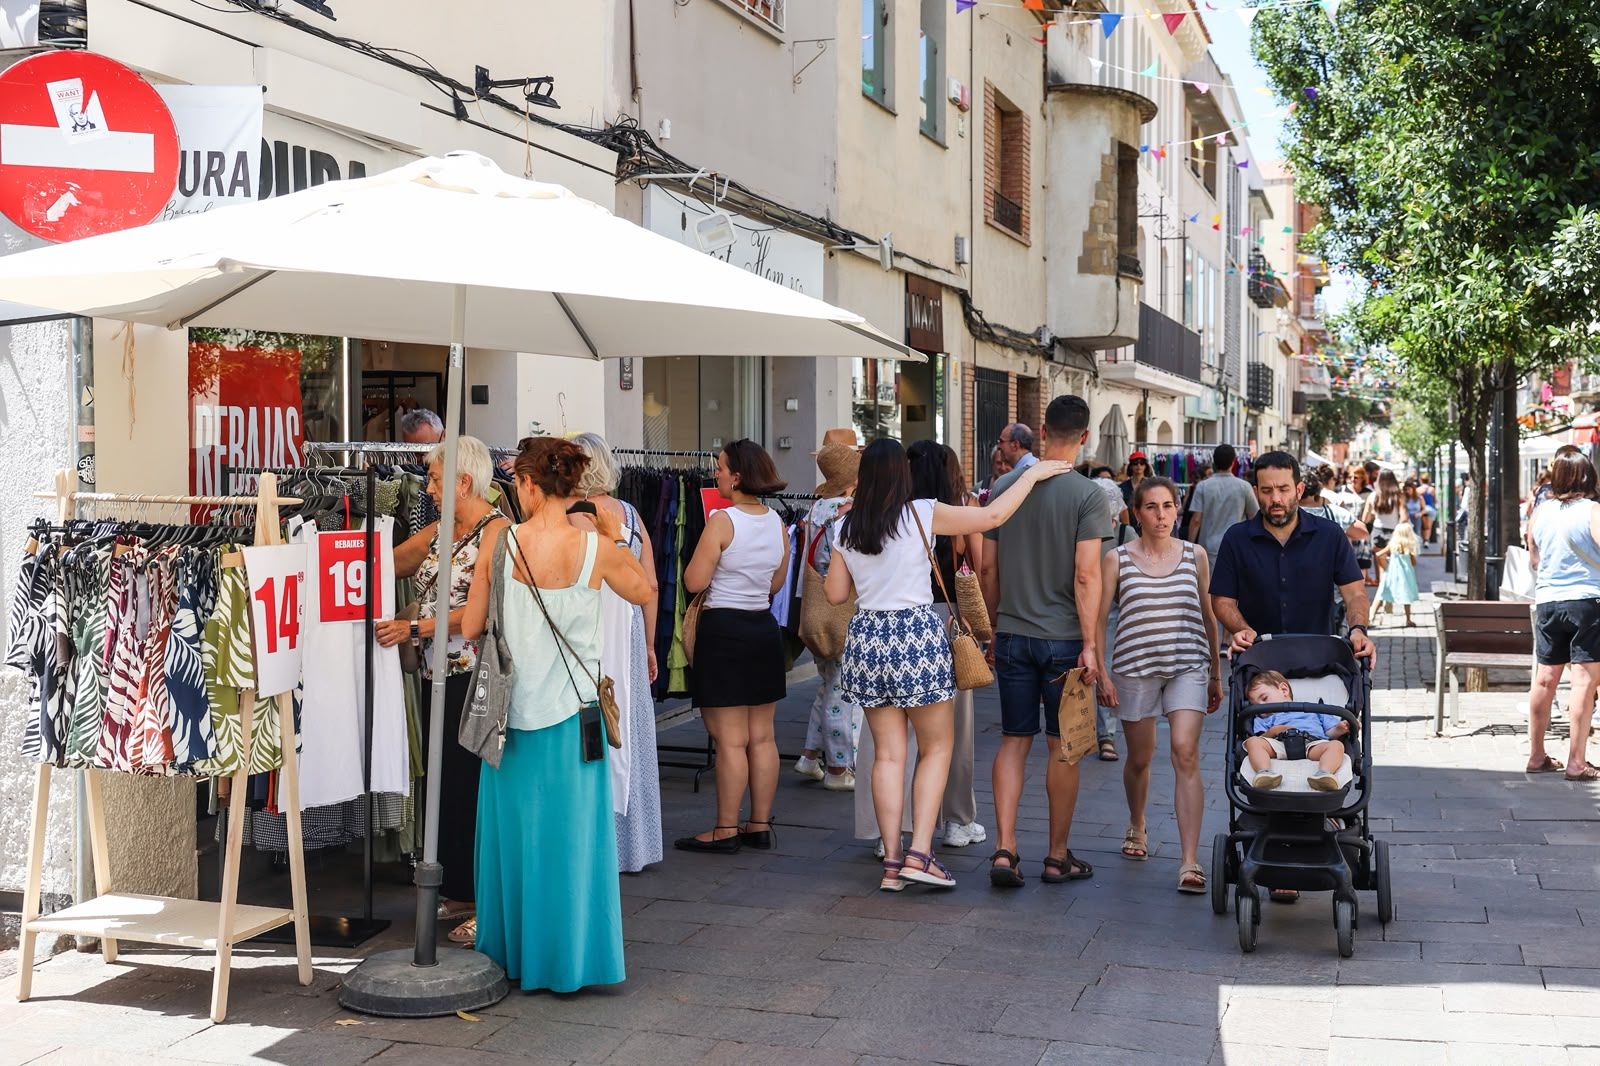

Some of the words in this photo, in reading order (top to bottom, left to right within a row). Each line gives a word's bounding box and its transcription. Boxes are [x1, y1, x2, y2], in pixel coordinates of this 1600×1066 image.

[334, 539, 365, 549] REBAIXES
[328, 559, 367, 607] 19
[255, 574, 299, 654] 14
